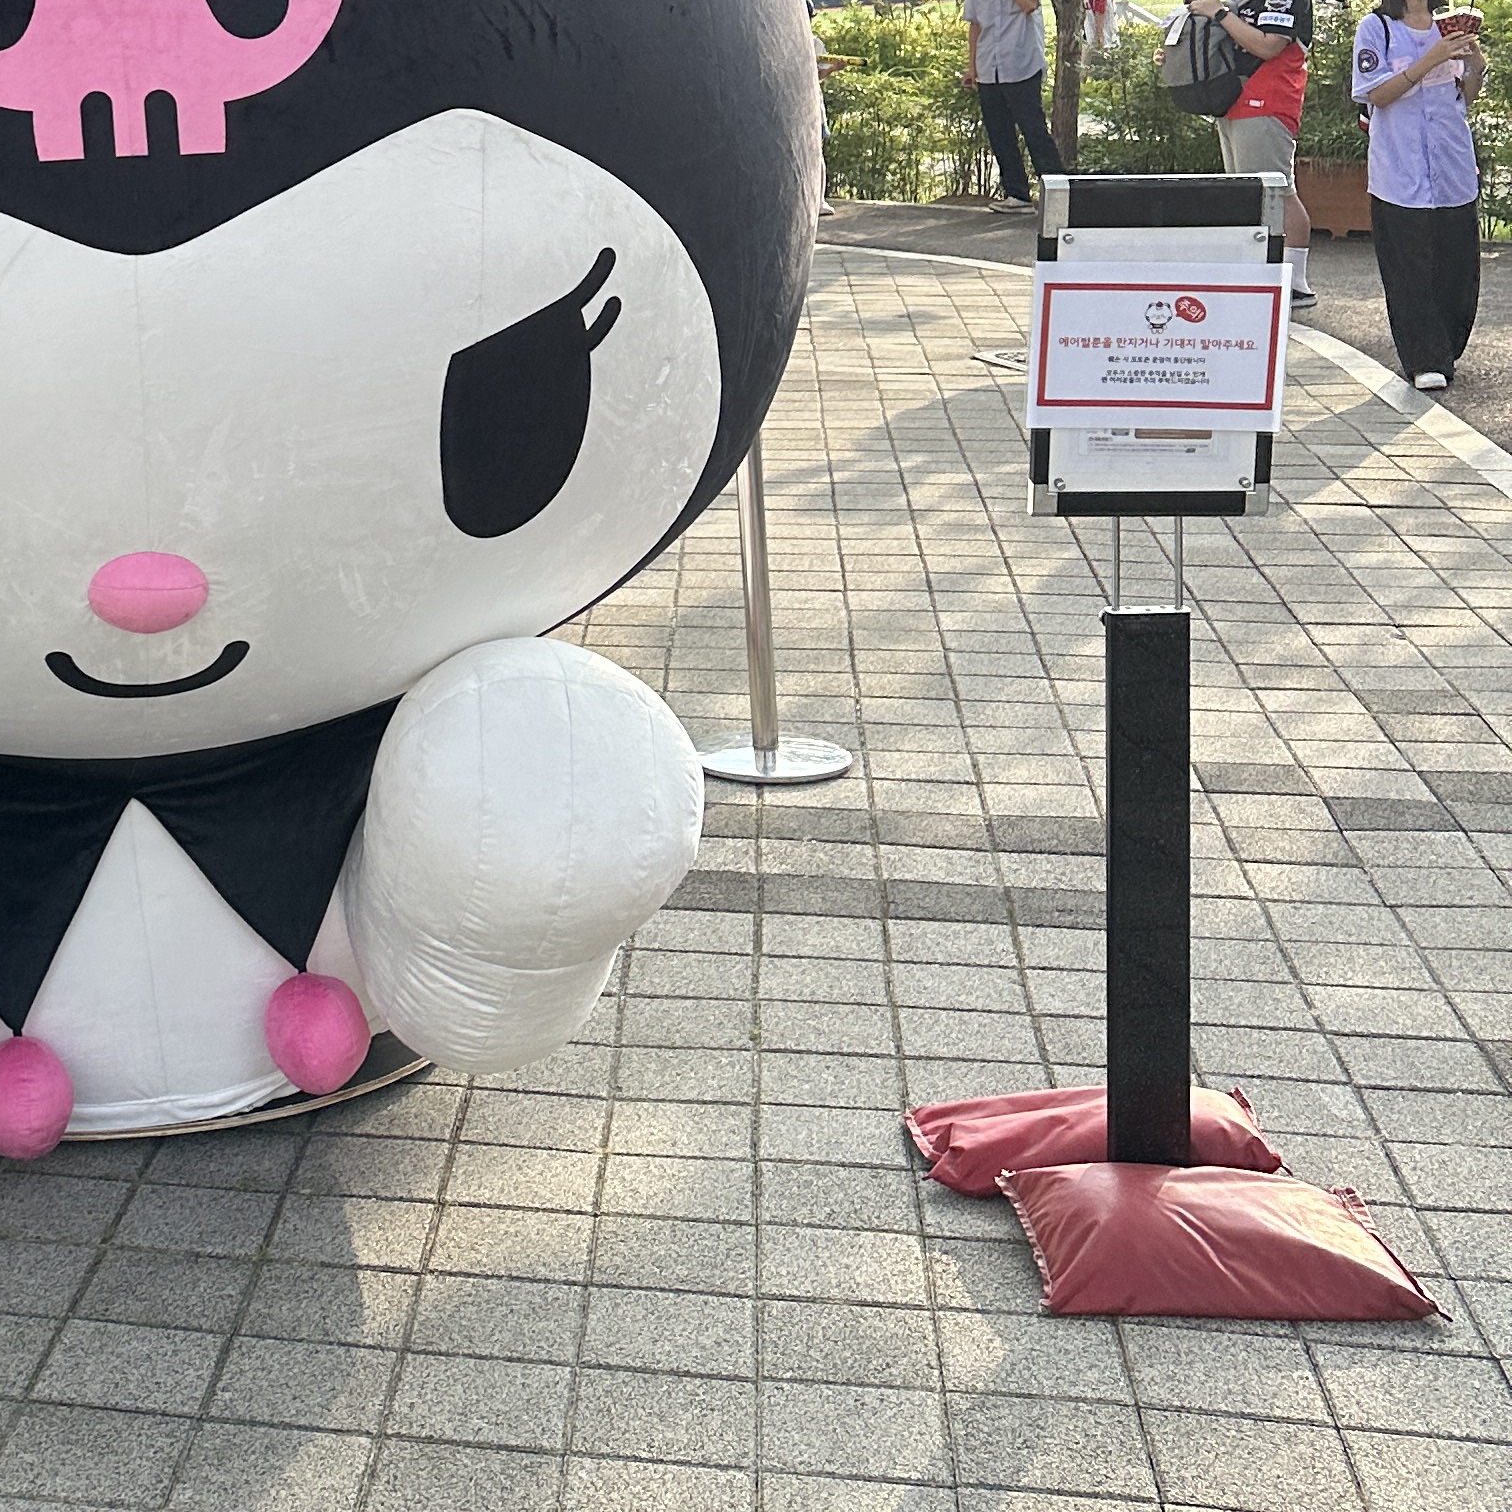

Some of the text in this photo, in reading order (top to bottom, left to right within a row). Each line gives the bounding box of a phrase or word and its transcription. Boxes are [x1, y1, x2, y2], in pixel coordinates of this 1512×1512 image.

[1116, 336, 1160, 349] 만지거나
[1163, 337, 1196, 350] 기대지
[1200, 338, 1258, 351] 말아주세요.
